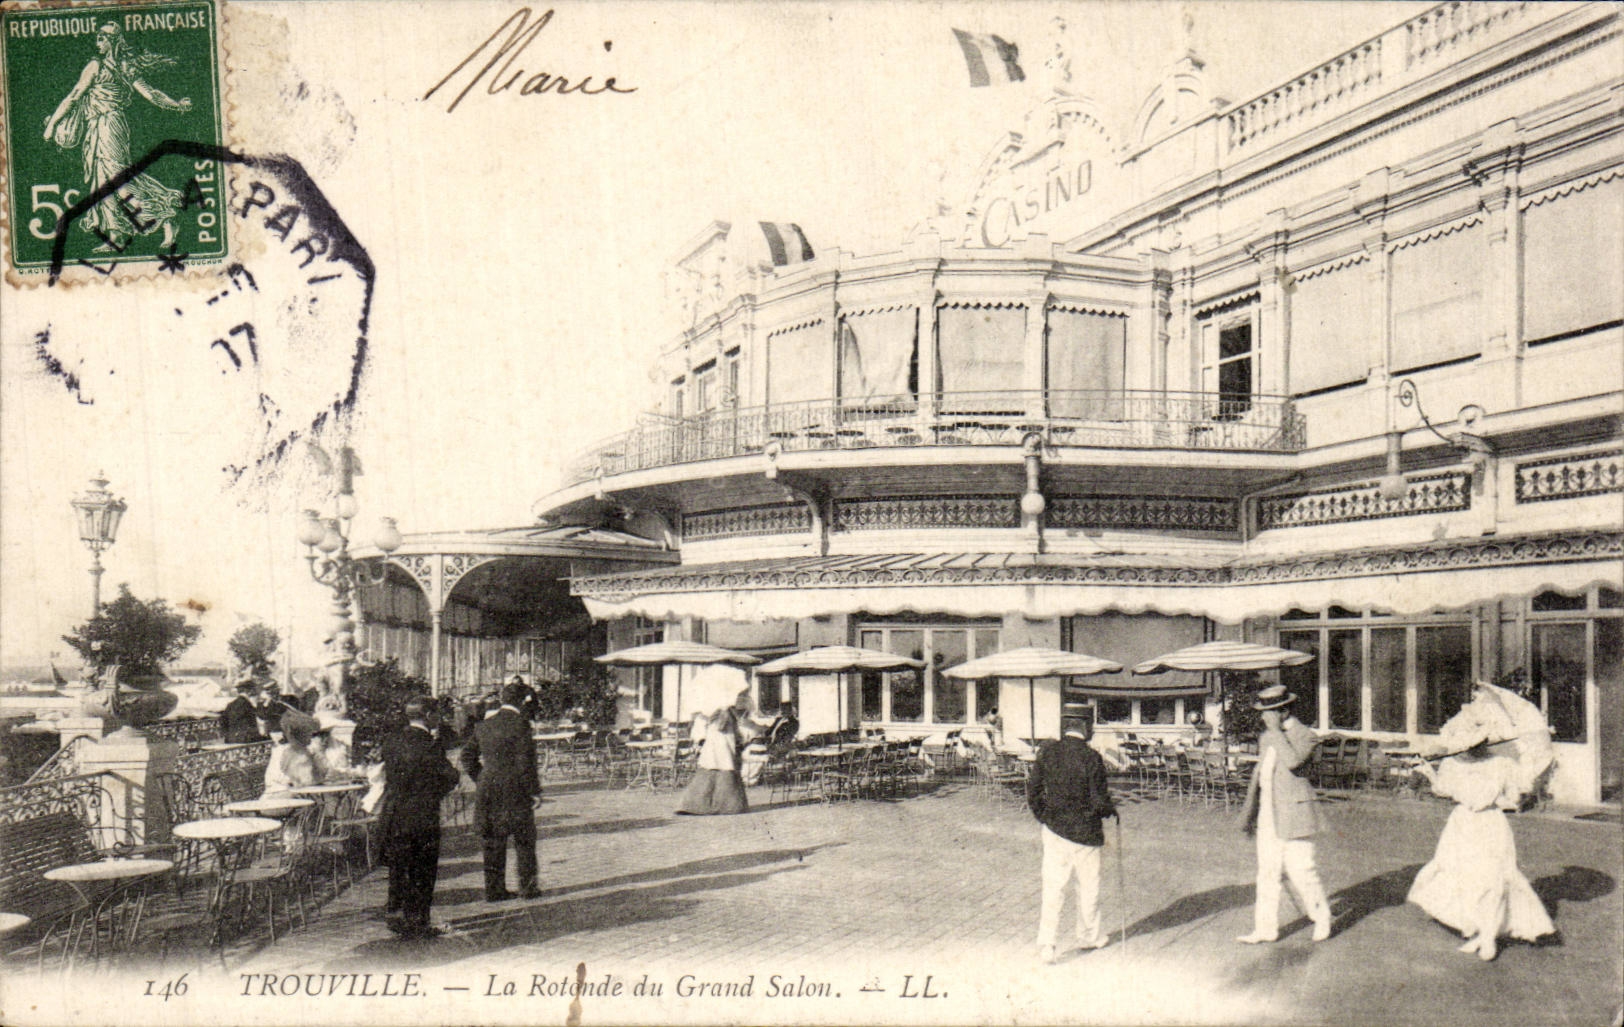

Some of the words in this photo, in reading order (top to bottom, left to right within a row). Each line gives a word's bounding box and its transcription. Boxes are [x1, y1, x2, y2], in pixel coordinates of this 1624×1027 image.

[124, 11, 206, 32] FRANÇAISE
[423, 7, 638, 113] Marie
[981, 159, 1093, 249] CASINO
